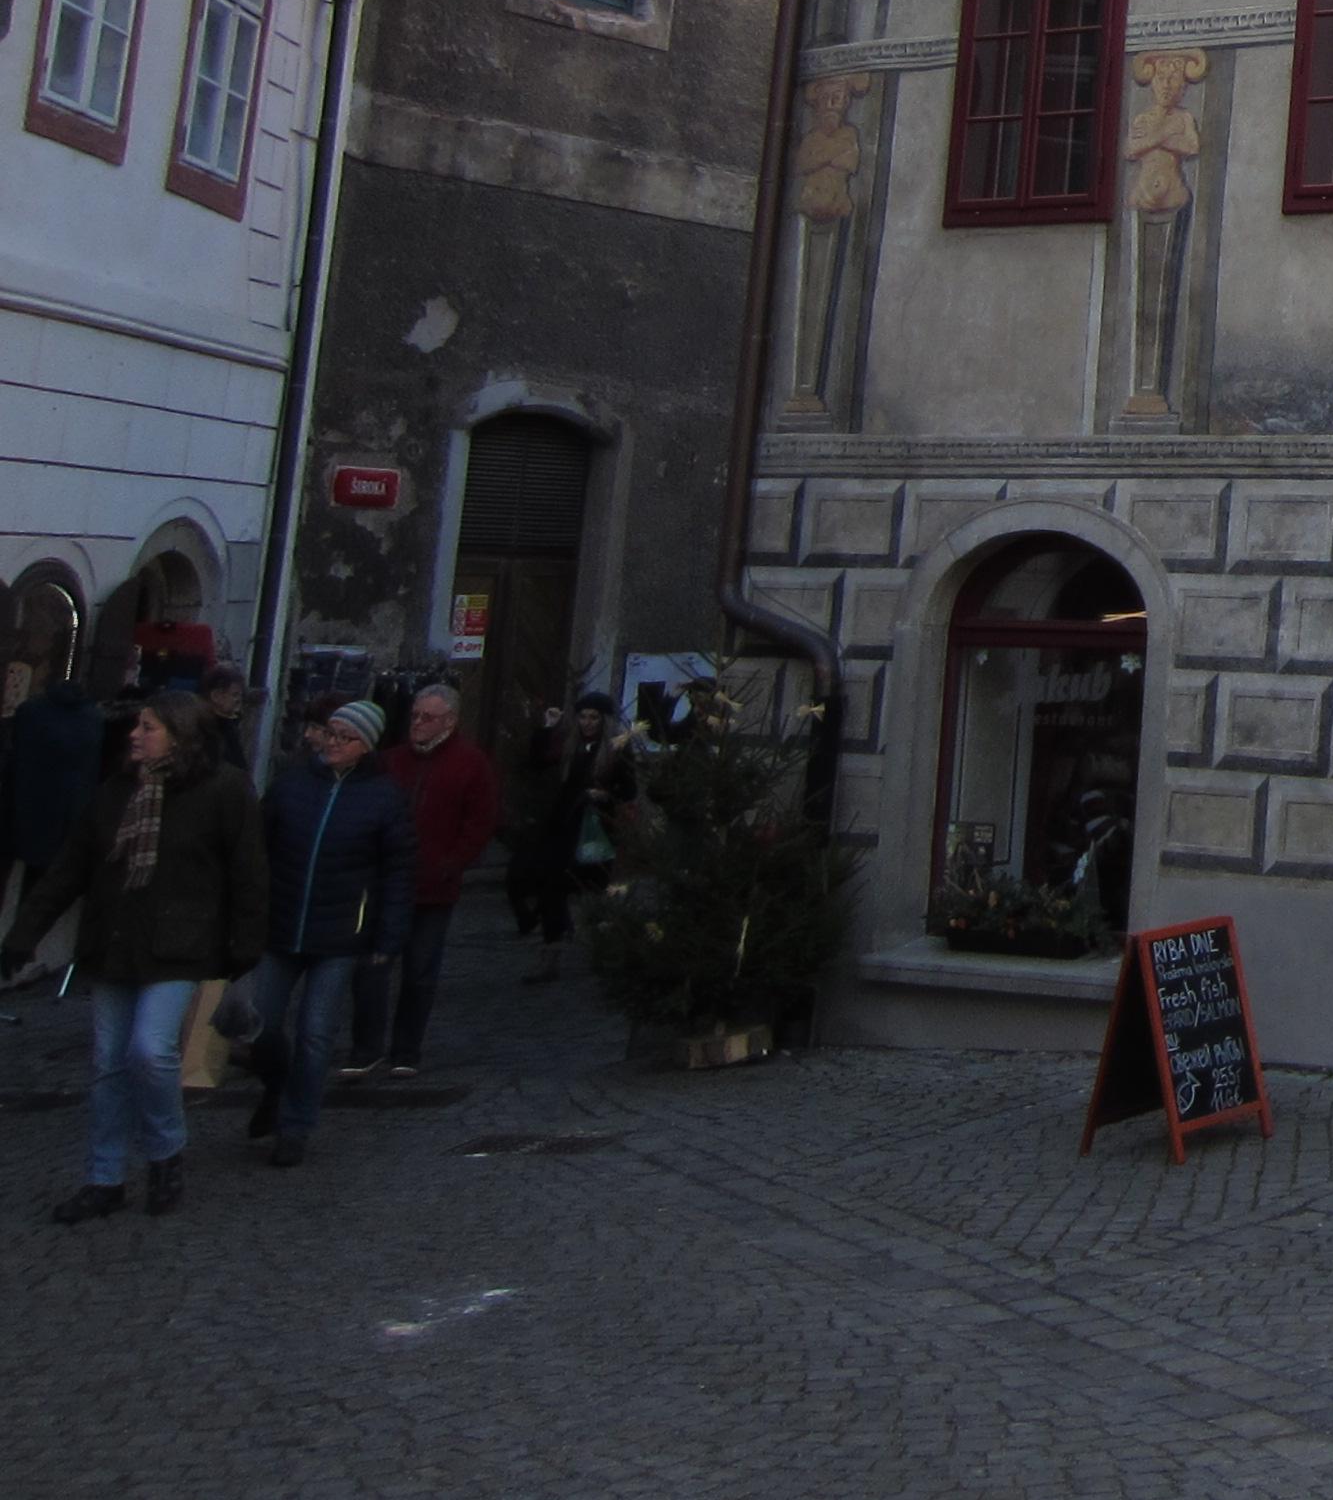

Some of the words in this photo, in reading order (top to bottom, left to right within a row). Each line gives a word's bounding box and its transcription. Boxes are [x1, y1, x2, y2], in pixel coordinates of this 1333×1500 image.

[1152, 937, 1188, 964] RYBA
[1190, 930, 1219, 955] DNE
[1158, 980, 1197, 1010] Fresh
[1200, 972, 1228, 1000] fish
